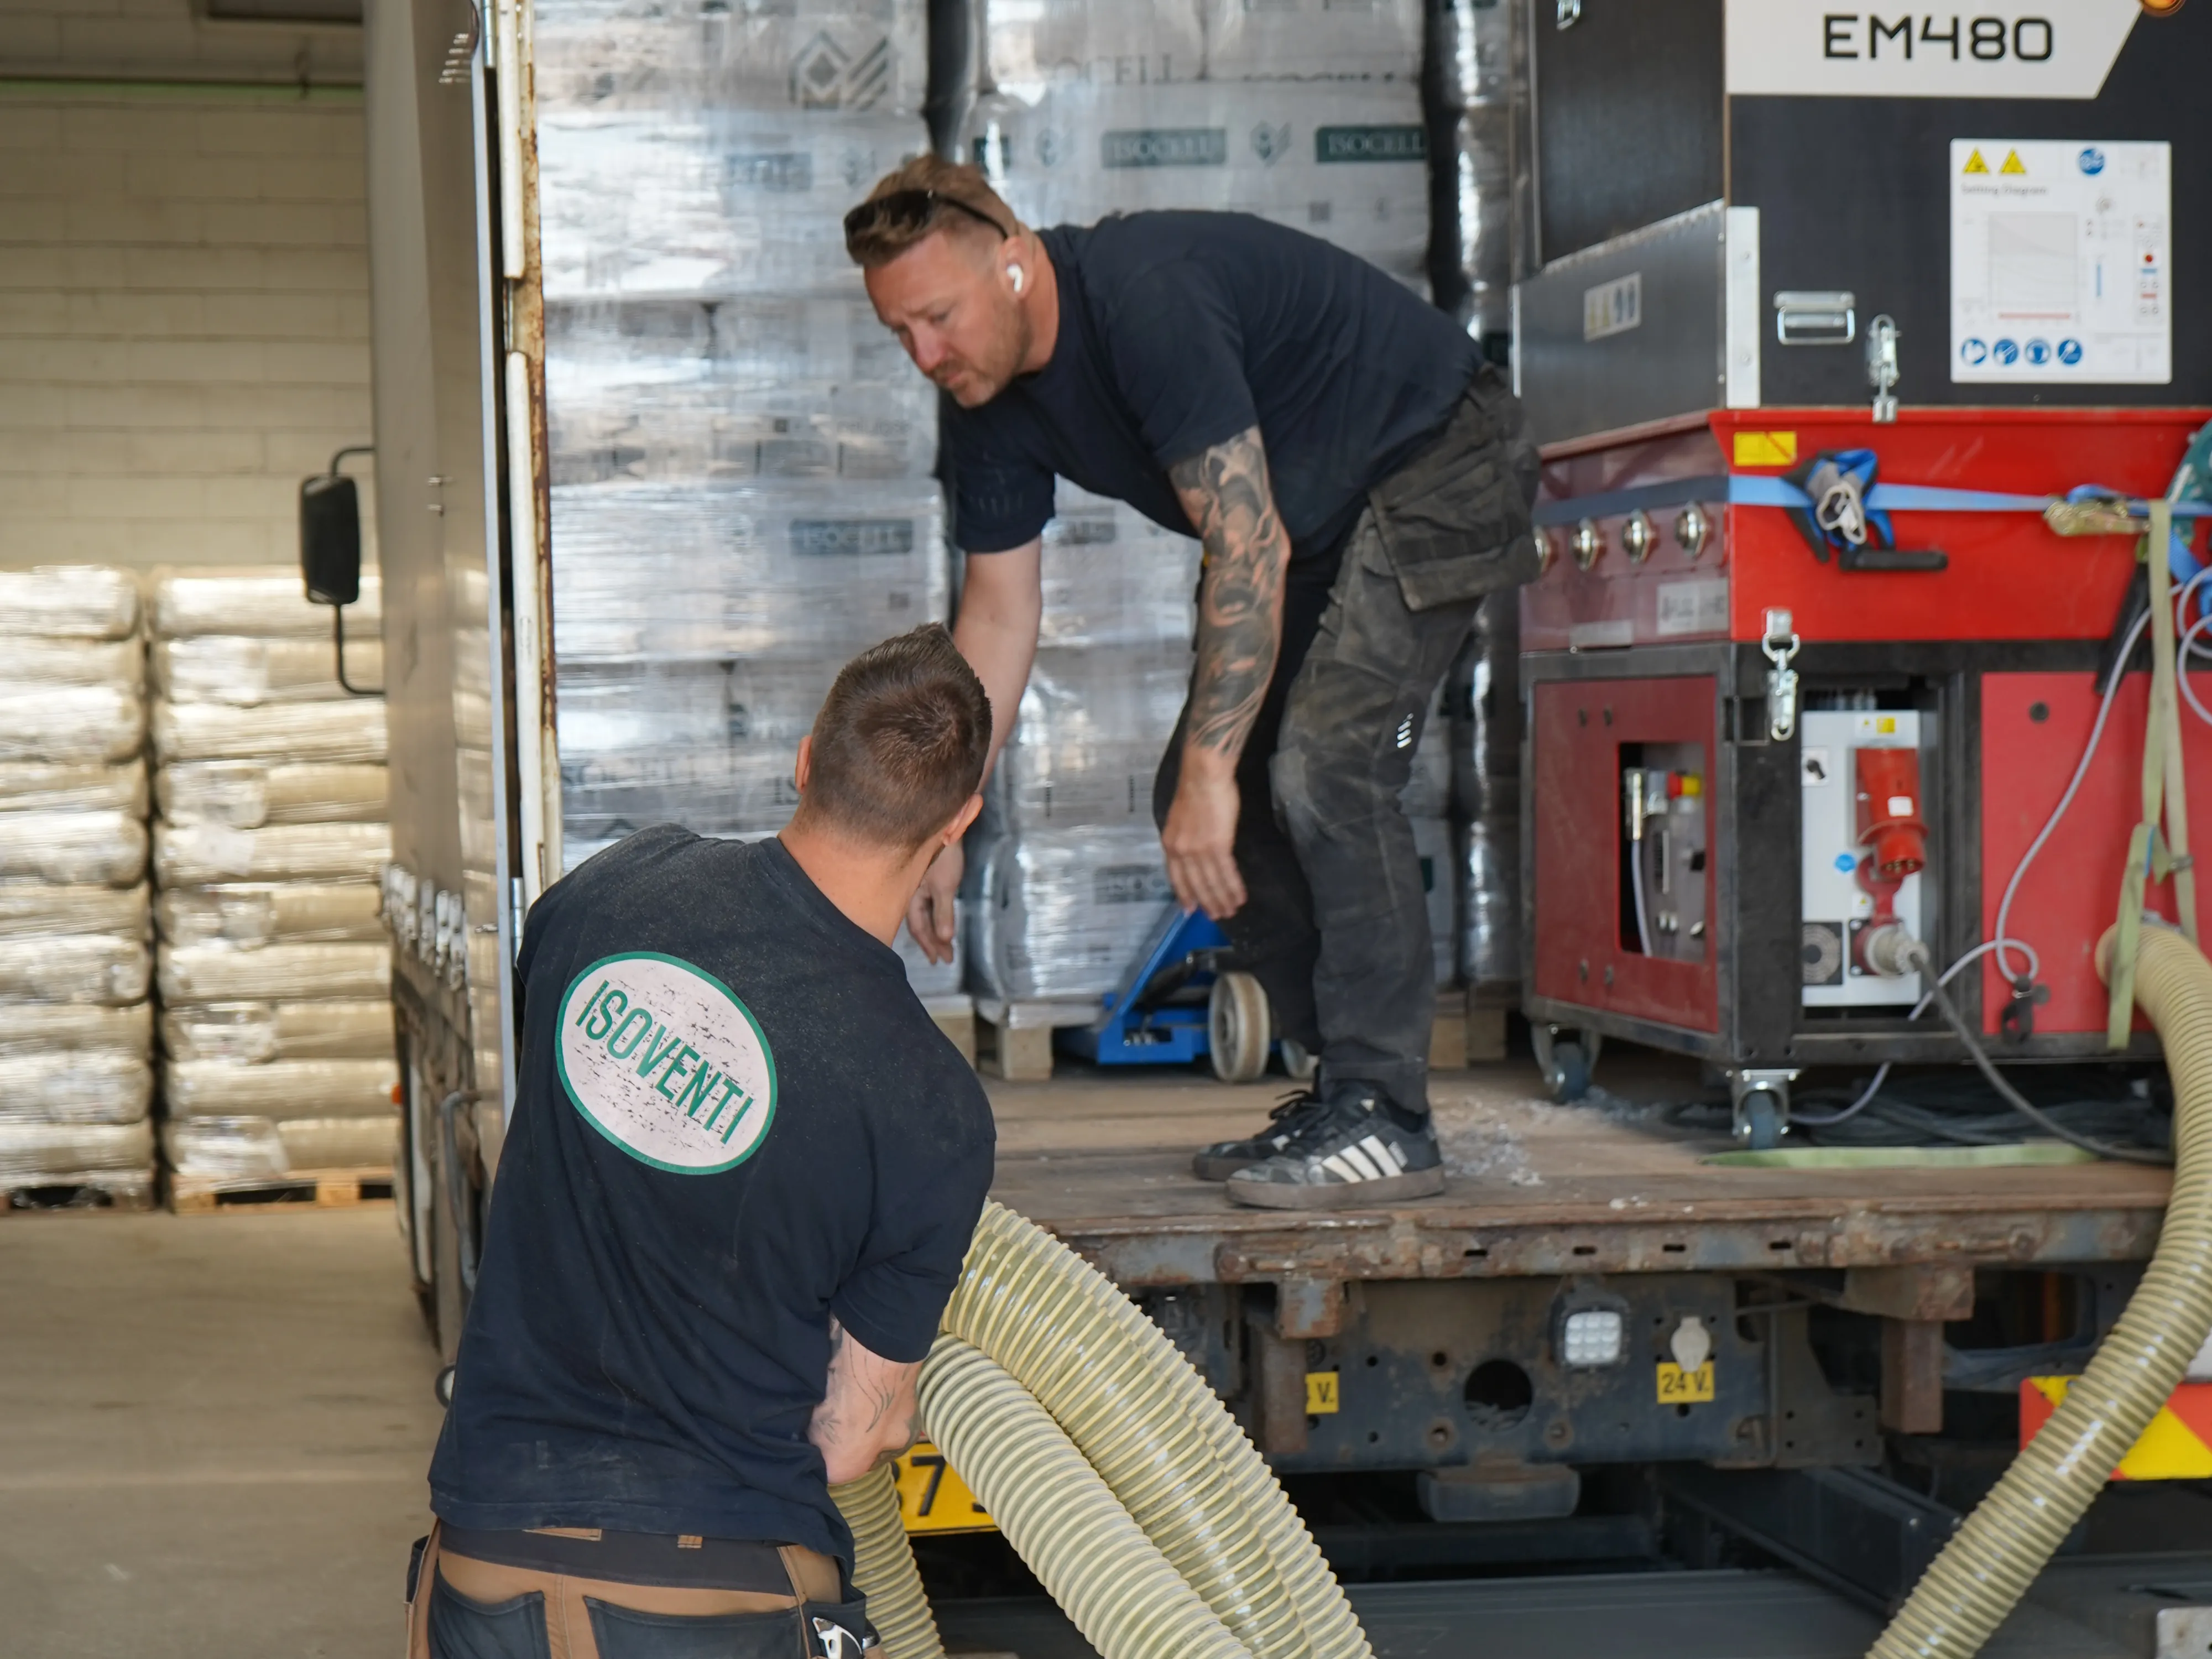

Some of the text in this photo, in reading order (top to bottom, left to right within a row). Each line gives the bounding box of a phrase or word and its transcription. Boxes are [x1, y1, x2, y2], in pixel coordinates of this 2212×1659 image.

[1823, 13, 2053, 61] EM480
[575, 980, 753, 1145] ISOVENTI
[1662, 1371, 1687, 1394] 24
